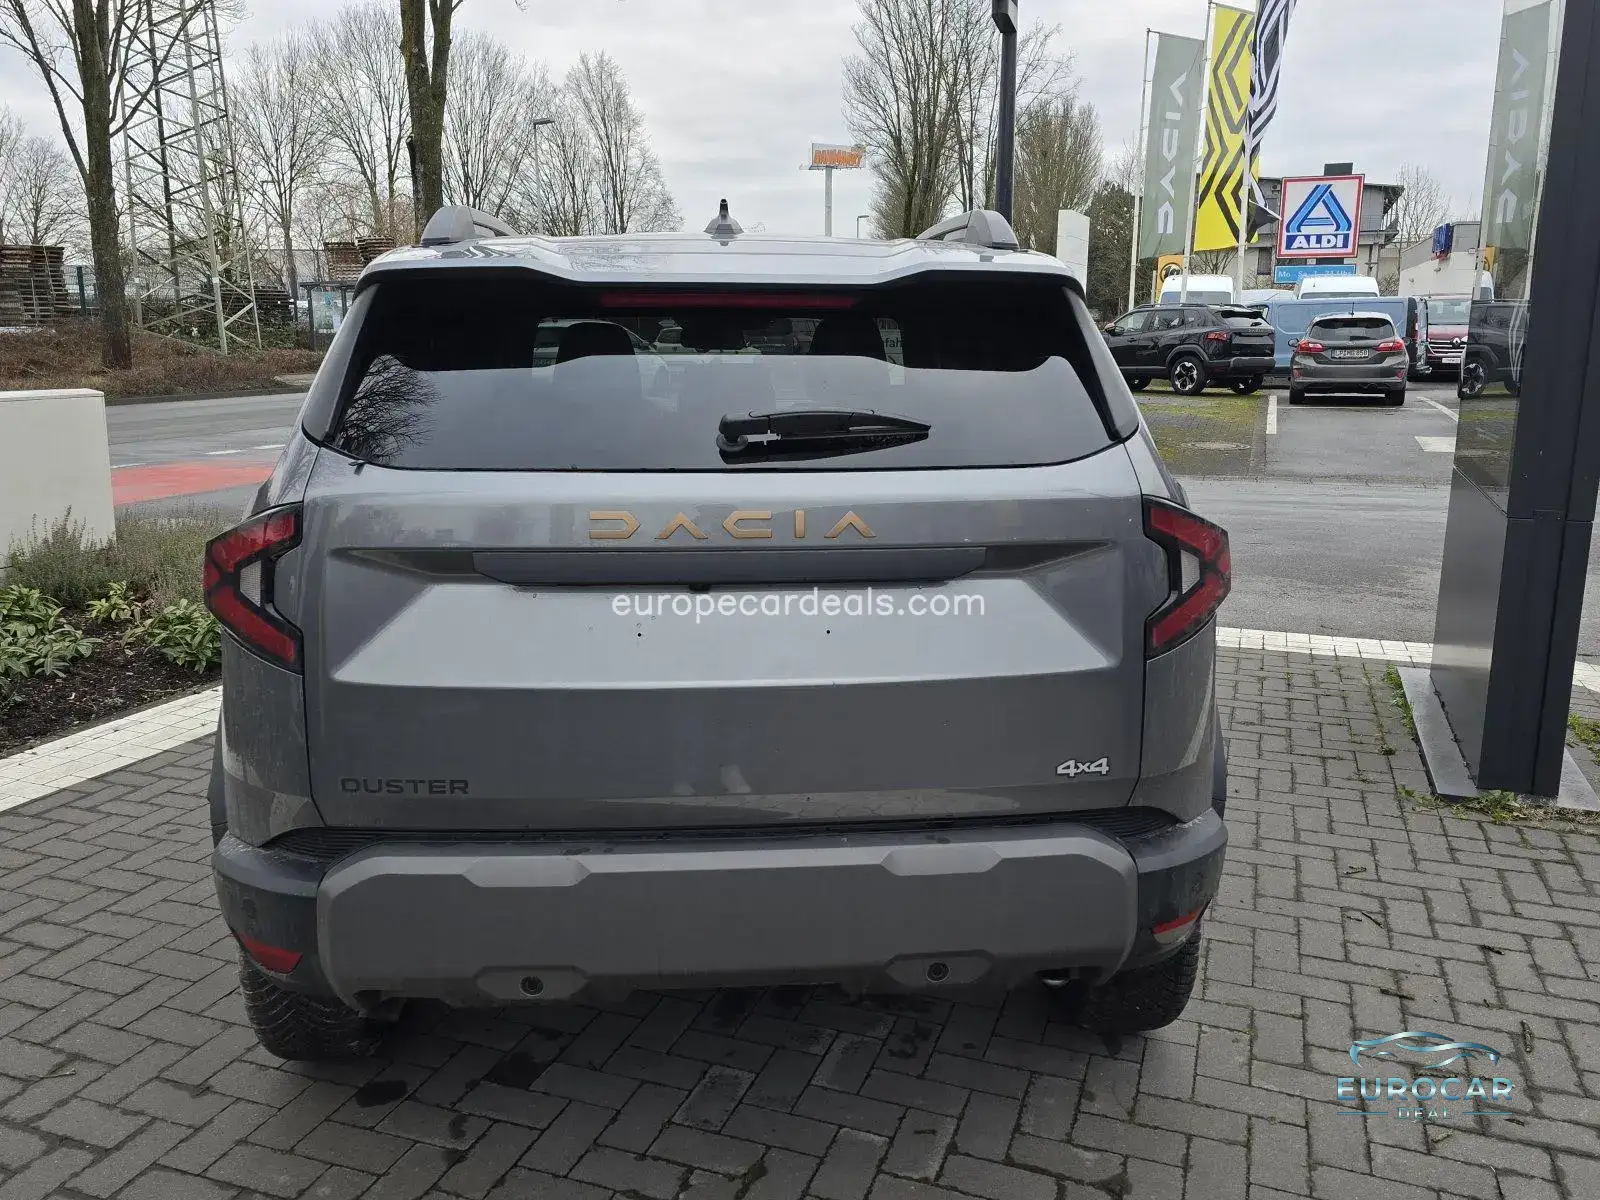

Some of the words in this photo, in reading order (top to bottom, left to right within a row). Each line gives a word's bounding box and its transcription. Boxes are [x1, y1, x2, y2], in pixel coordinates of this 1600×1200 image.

[1157, 71, 1187, 234] DACIA
[1290, 234, 1344, 249] ALDI
[589, 510, 876, 539] DACIA
[1057, 757, 1109, 777] 4x4
[340, 777, 469, 795] DUSTER
